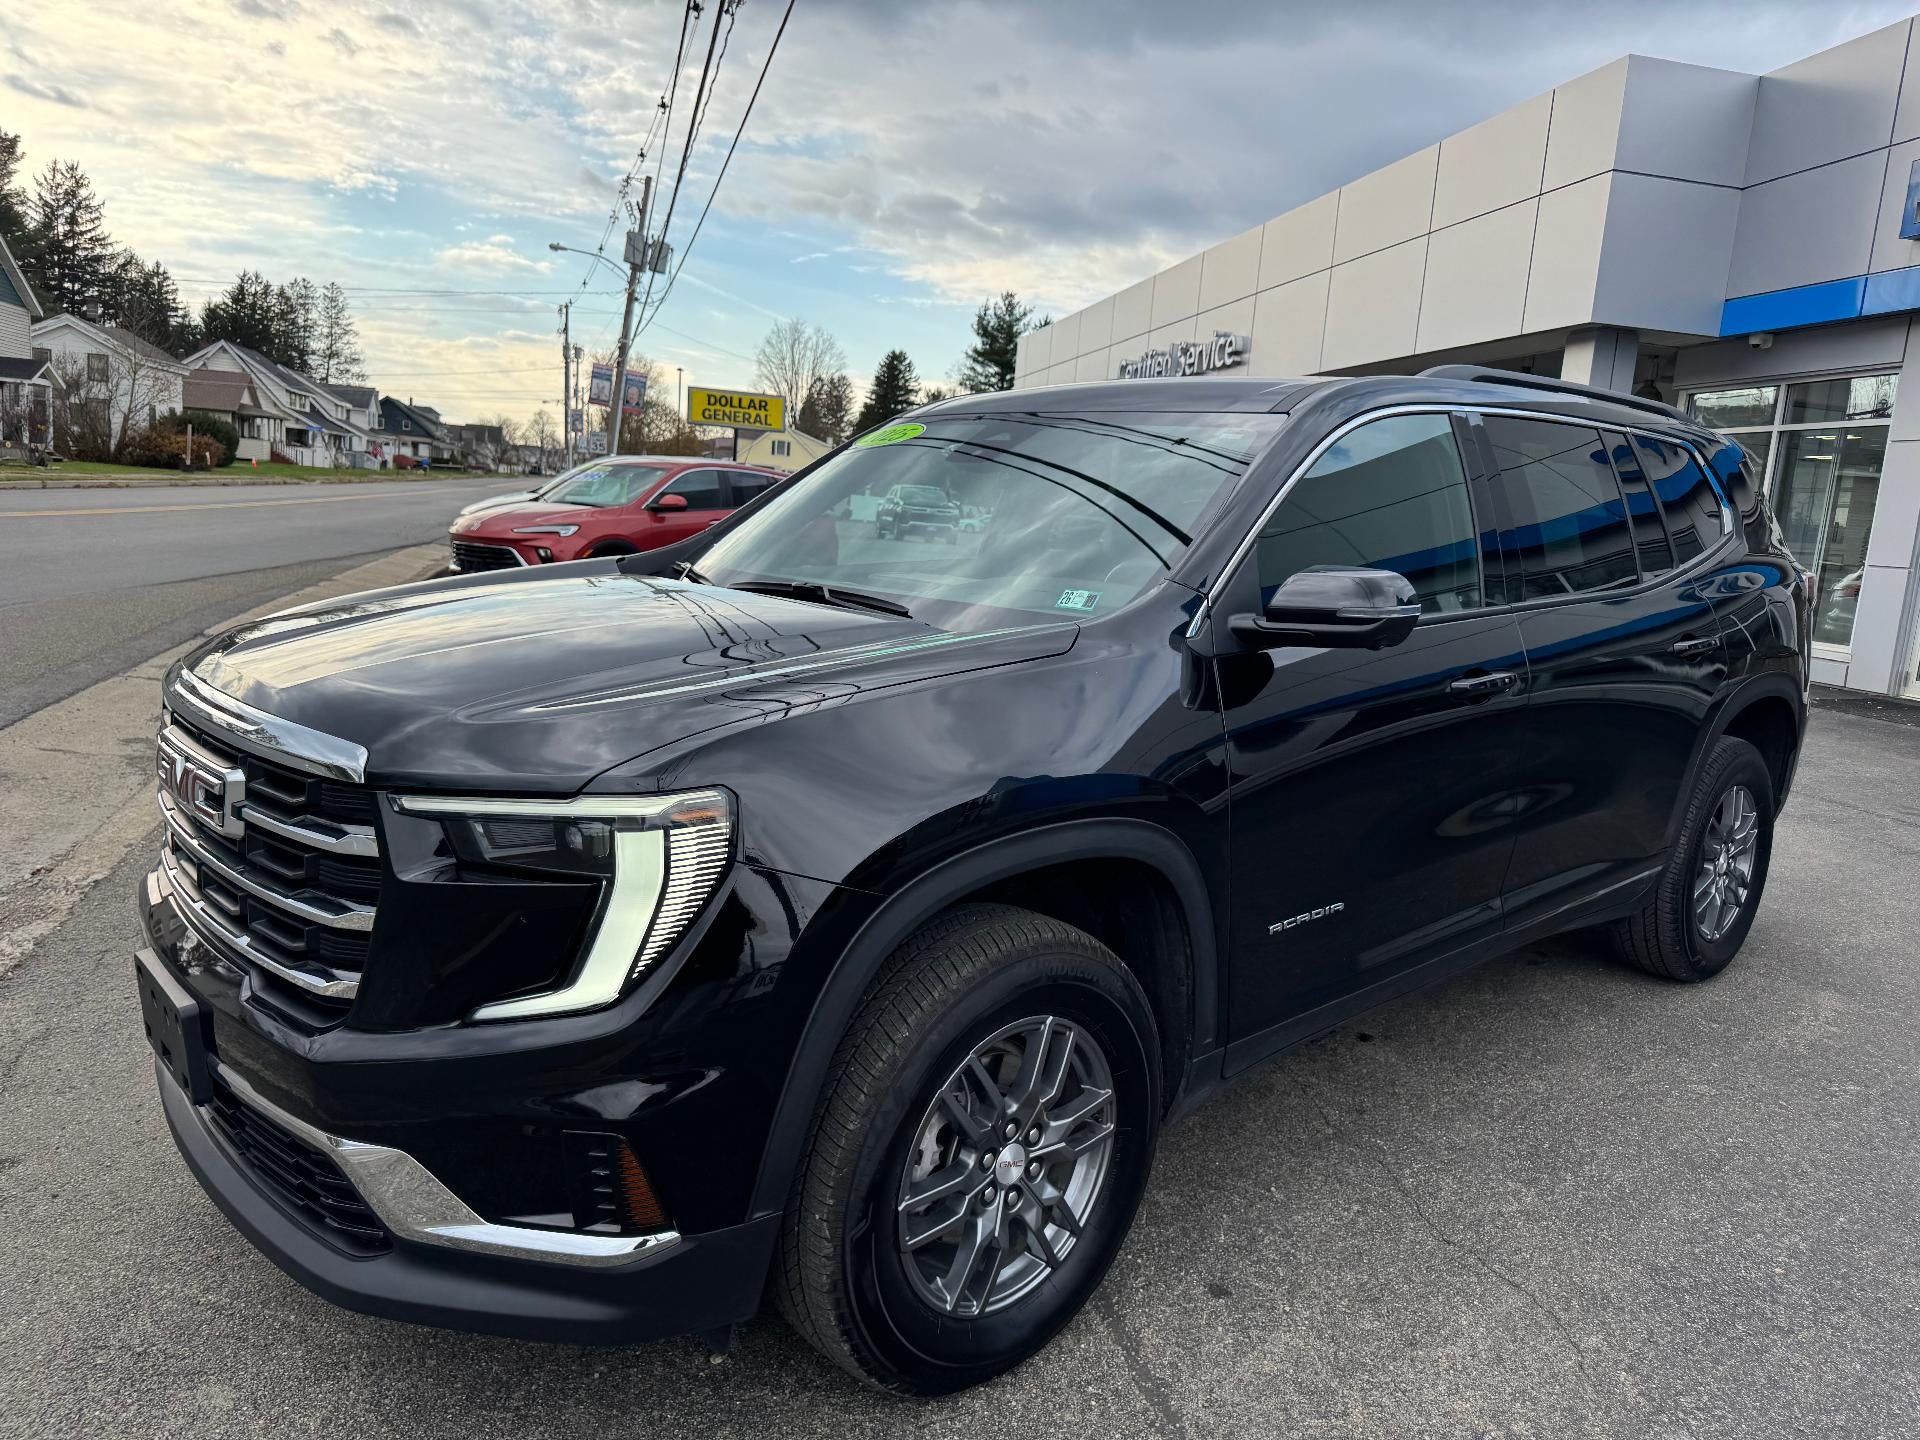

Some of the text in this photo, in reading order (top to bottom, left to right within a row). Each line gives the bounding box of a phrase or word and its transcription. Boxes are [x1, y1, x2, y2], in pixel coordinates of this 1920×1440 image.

[1119, 330, 1239, 379] Certified Service
[707, 393, 769, 412] DOLLAR
[701, 408, 772, 427] GENERAL
[1268, 902, 1345, 936] ACADIA
[999, 1159, 1024, 1169] GMC
